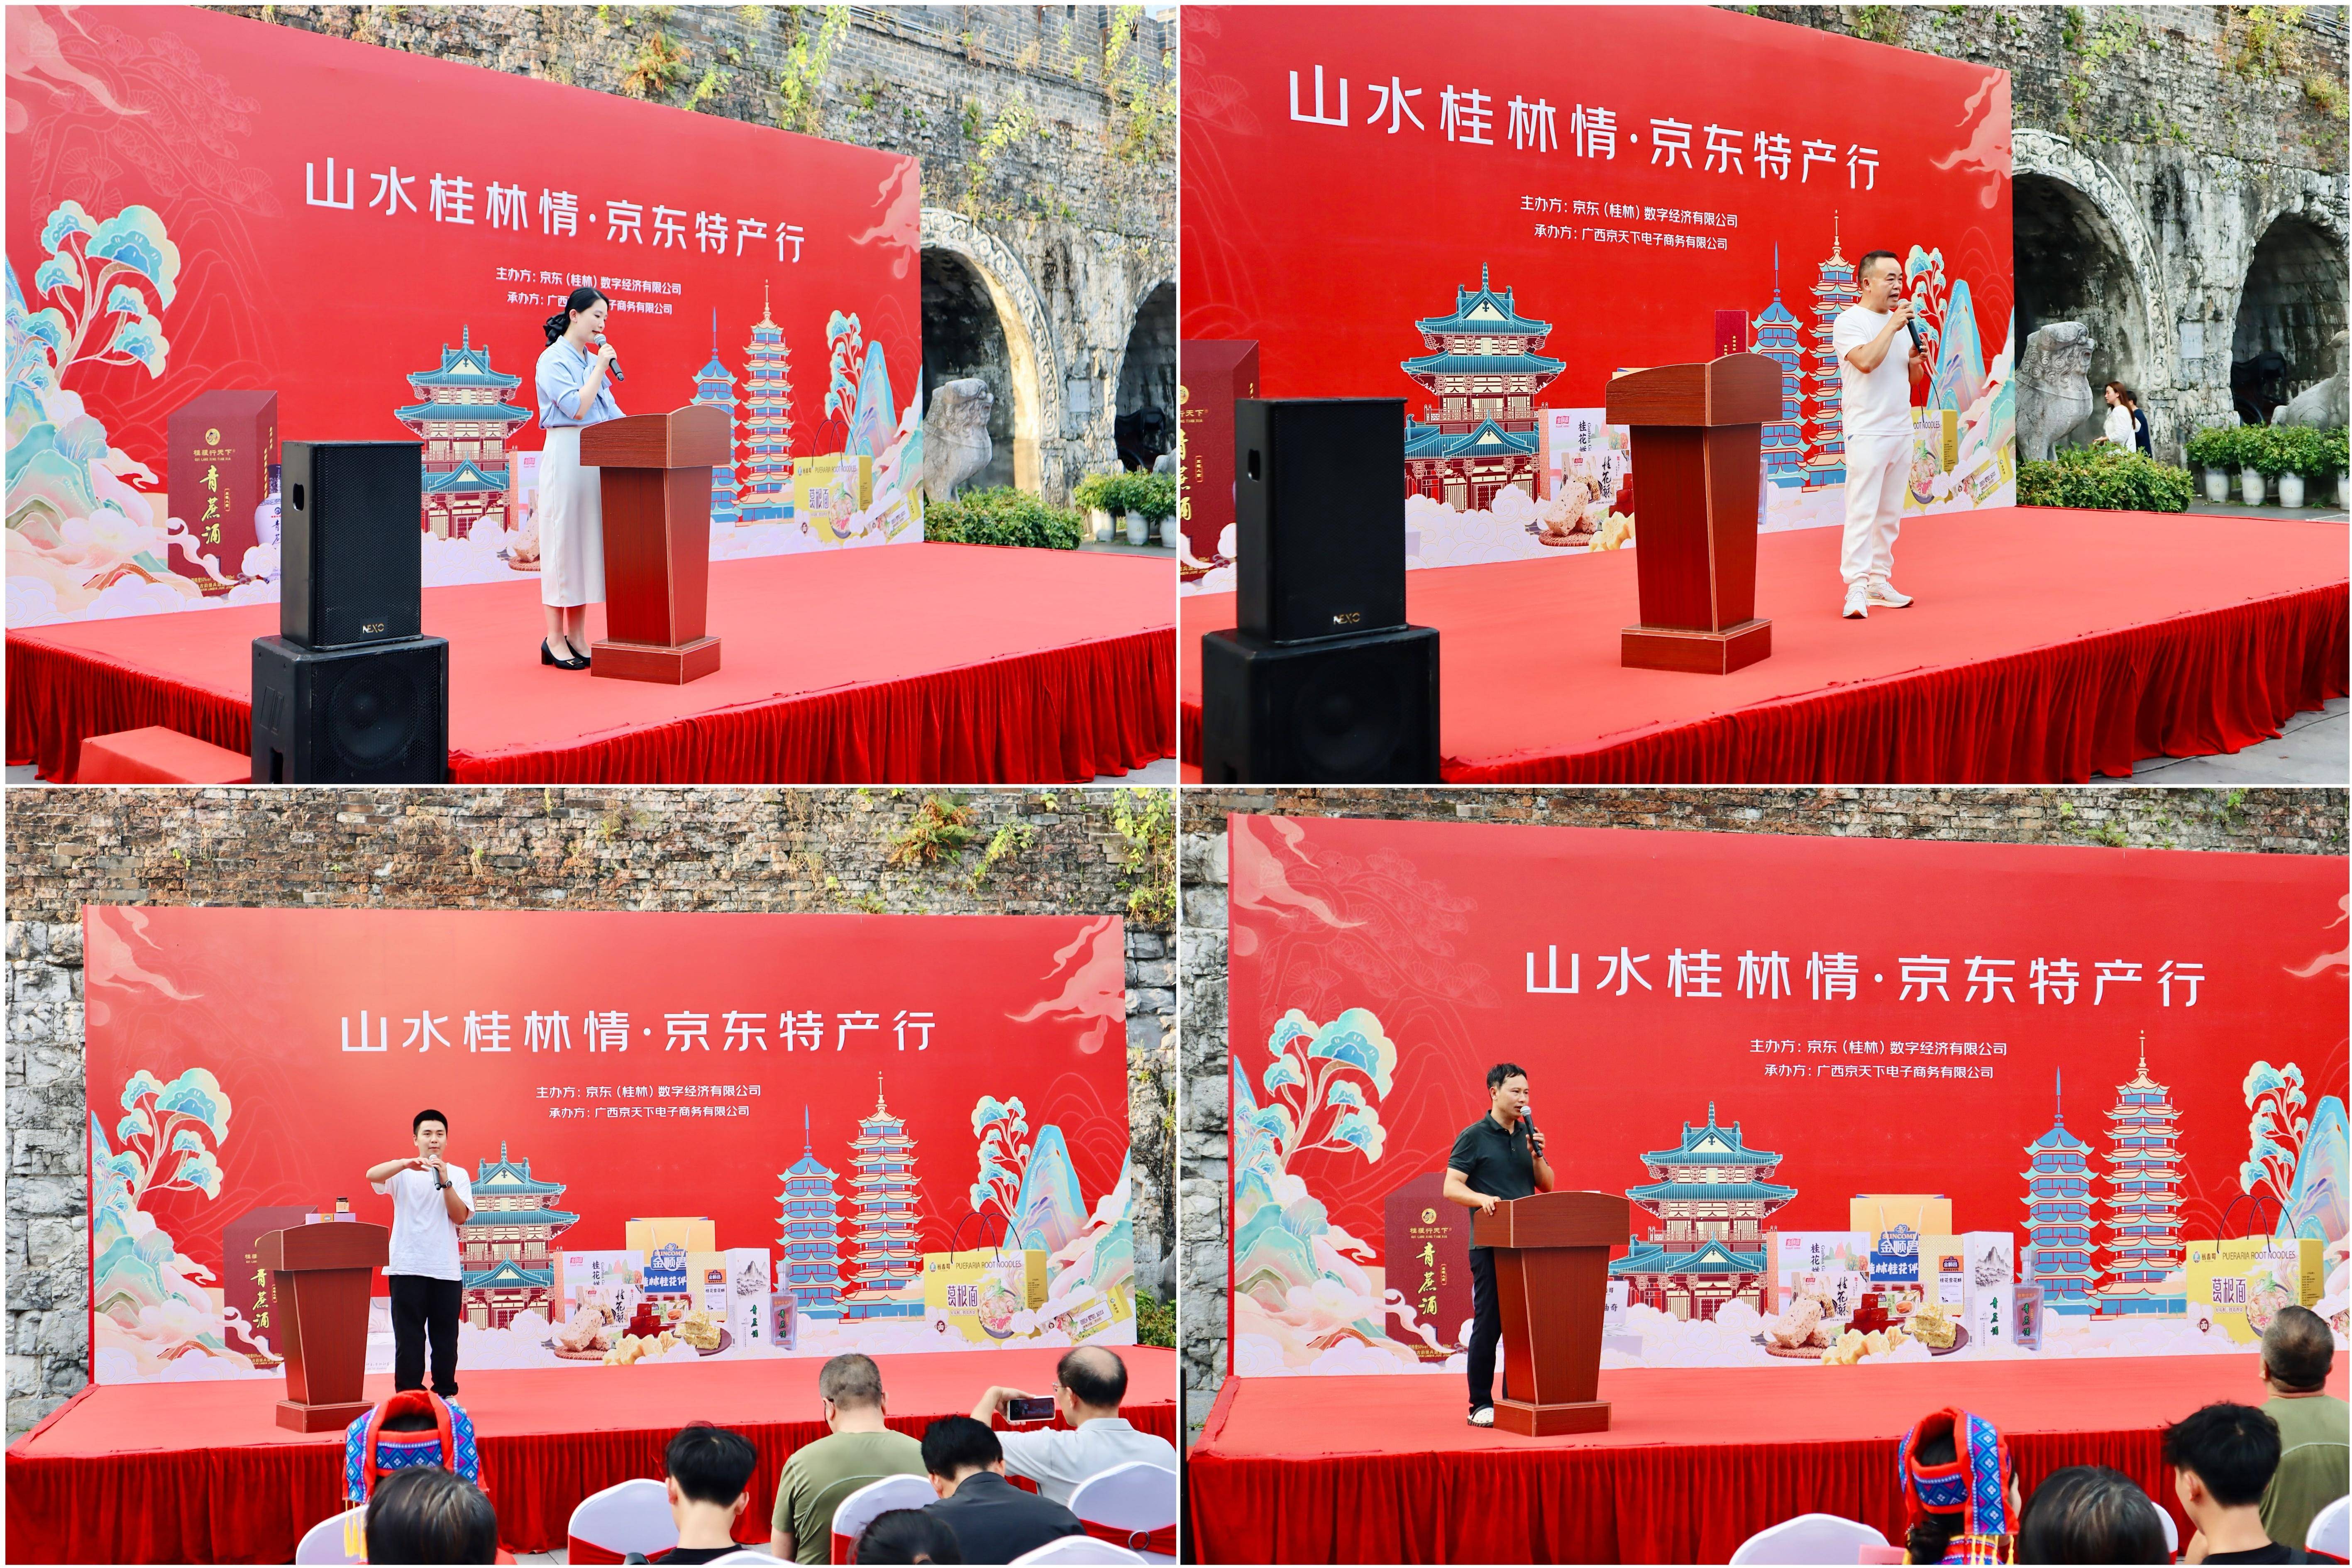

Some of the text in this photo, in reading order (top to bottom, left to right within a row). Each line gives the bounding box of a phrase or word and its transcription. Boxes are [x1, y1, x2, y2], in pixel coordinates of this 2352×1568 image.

[1290, 64, 1880, 191] 山水桂林情·京东特产行
[306, 157, 805, 263] 山水桂林情·京东特产行
[363, 623, 384, 634] NEXO
[1334, 613, 1360, 625] NEXO
[1525, 945, 2205, 1007] 山水桂林情·京东特产行
[342, 1010, 935, 1053] 山水桂林情·京东特产行
[1764, 1064, 1993, 1079] 承办方：广西京天下电子商务有限公司
[549, 1106, 750, 1118] 承办方：广西京天下电子商务有限公司
[947, 1285, 977, 1307] 葛根面
[2212, 1278, 2246, 1303] 葛根面
